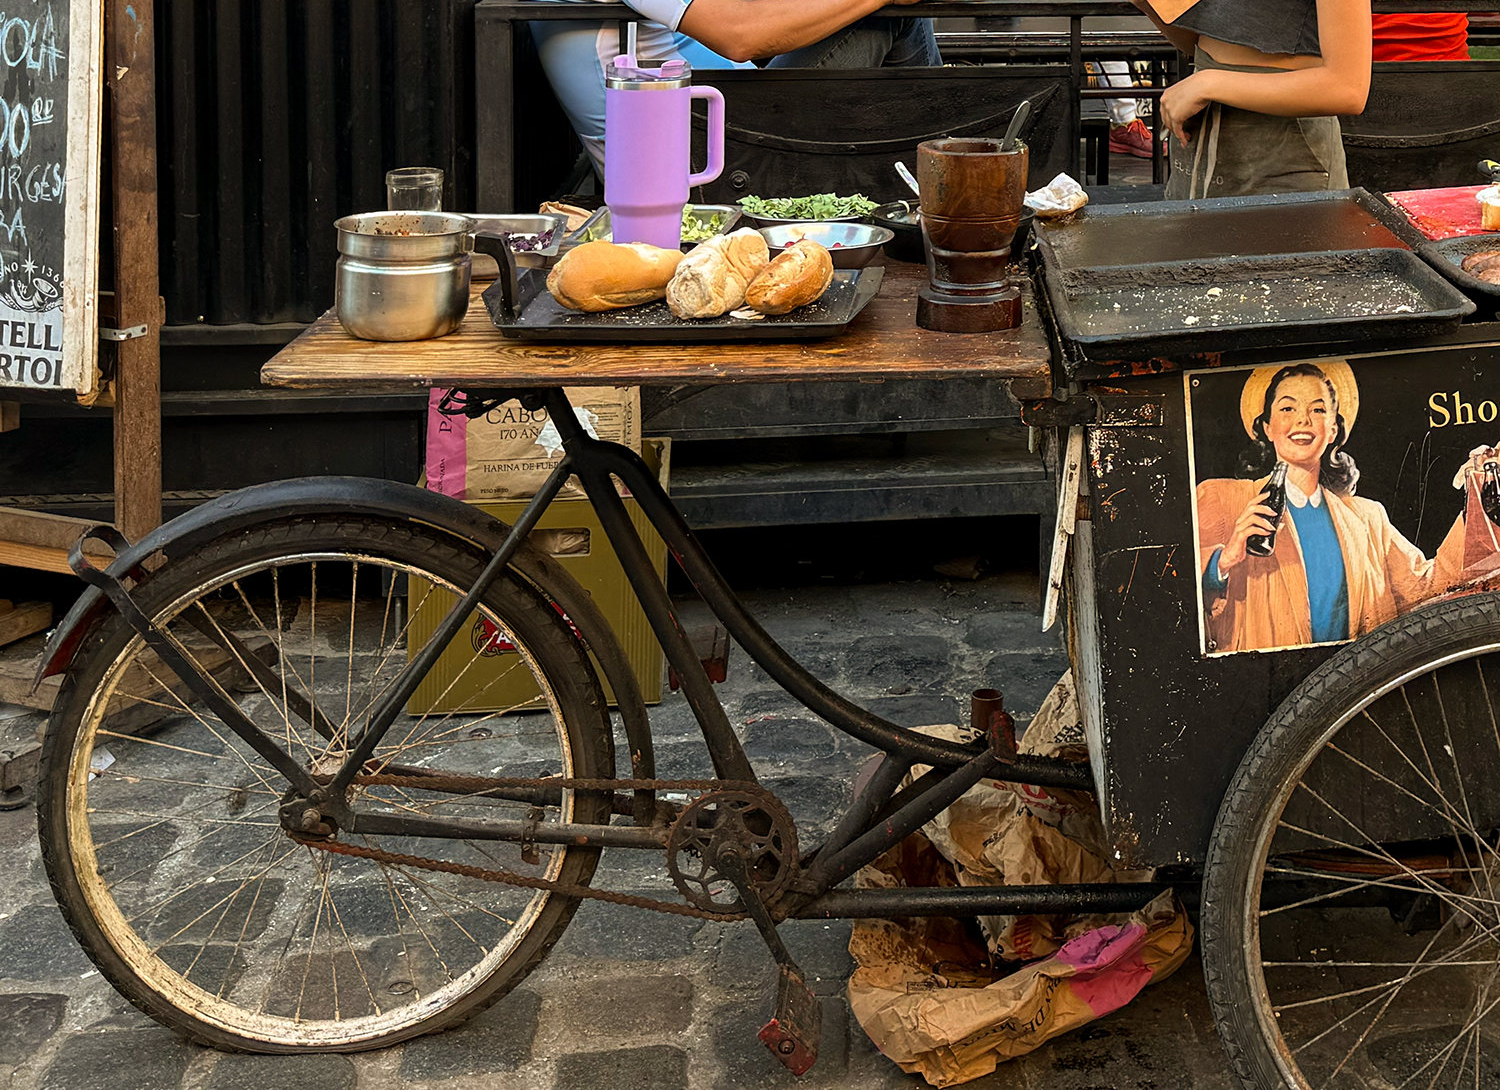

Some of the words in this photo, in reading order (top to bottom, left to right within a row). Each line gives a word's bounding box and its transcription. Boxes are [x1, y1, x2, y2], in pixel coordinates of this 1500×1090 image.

[0, 319, 63, 353] TELL
[500, 428, 518, 440] 170
[483, 462, 520, 473] HARINA
[522, 462, 535, 471] DE
